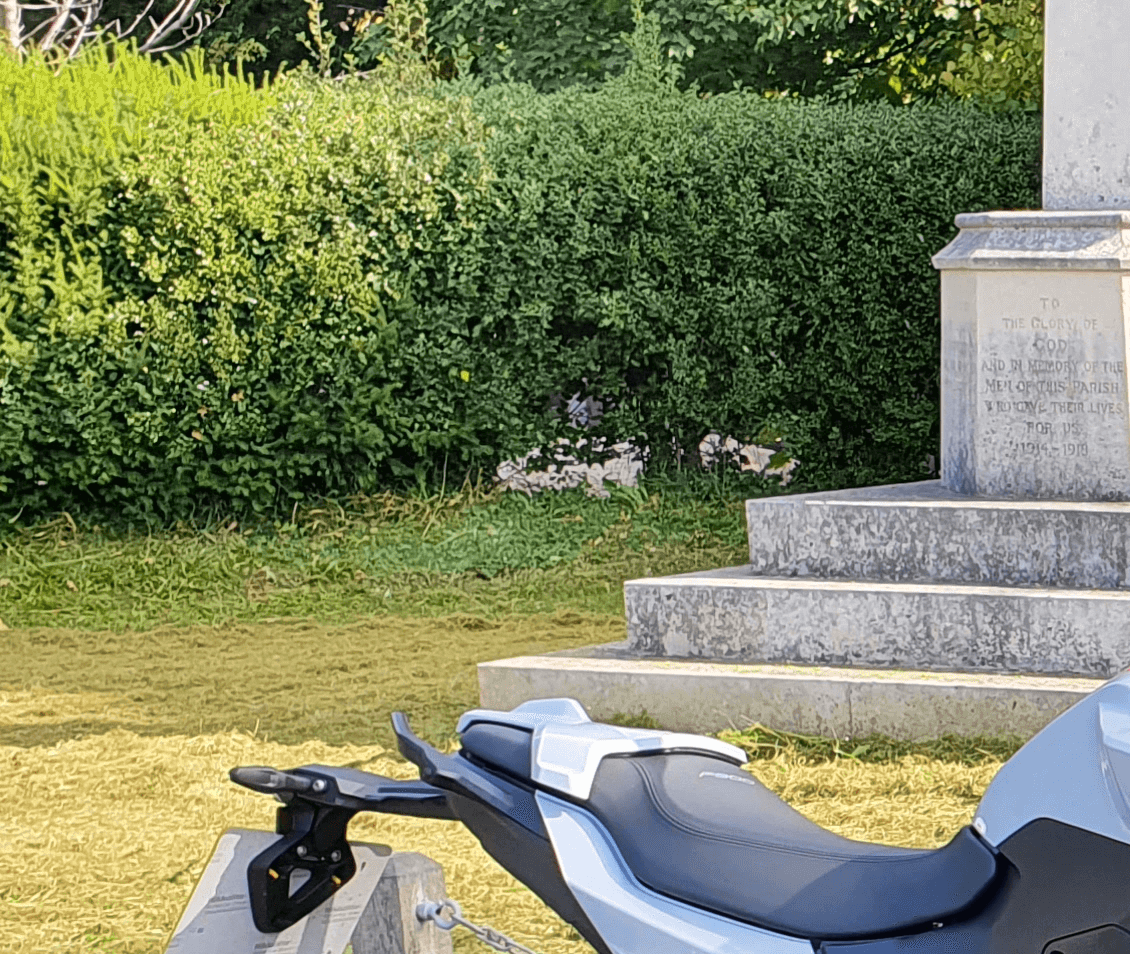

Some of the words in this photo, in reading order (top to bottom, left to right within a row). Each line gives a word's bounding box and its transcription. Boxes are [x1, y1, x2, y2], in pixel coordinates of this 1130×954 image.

[1040, 297, 1060, 310] TO
[1002, 317, 1025, 329] THE
[1031, 316, 1074, 331] GLORY
[1033, 338, 1067, 351] GOD
[982, 359, 1005, 371] AND
[1011, 359, 1022, 371] IN
[1028, 359, 1077, 372] MEMORY
[1084, 360, 1100, 372] OF
[1102, 360, 1124, 374] THE
[985, 379, 1013, 392] MEN
[1016, 380, 1033, 393] OF
[1037, 380, 1065, 393] THIS
[1074, 381, 1119, 394] PARISH
[984, 400, 1012, 412] WHO
[1050, 401, 1084, 414] THEIR
[1088, 402, 1124, 415] LIVES
[1026, 422, 1052, 435] FOR
[1063, 422, 1081, 436] US
